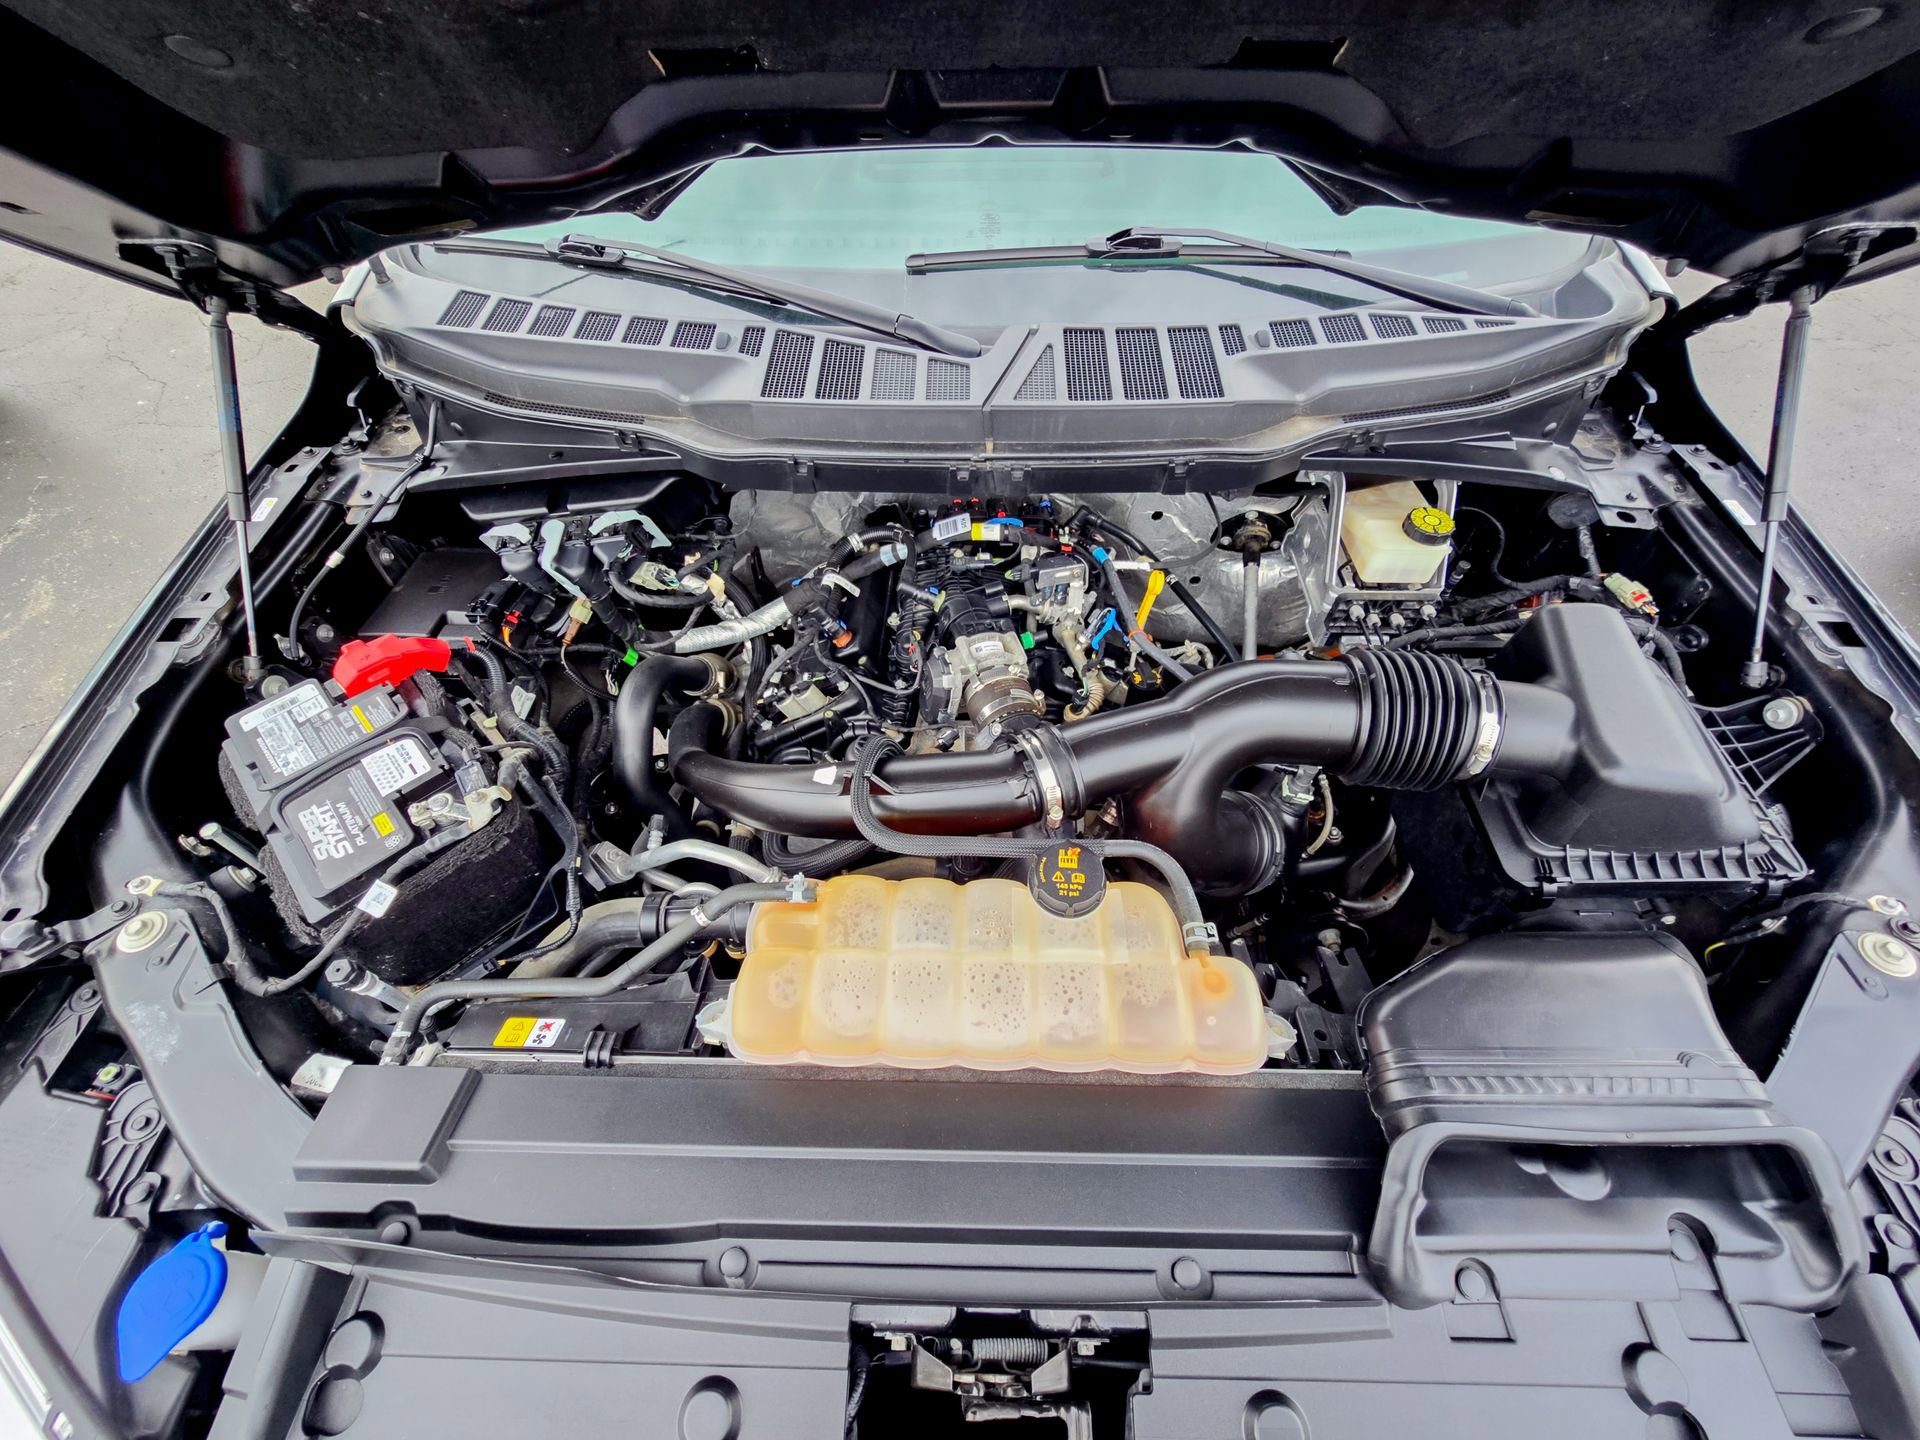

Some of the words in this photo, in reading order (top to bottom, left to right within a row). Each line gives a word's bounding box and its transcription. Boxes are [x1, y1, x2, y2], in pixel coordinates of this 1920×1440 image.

[297, 807, 330, 861] SUPER
[310, 802, 354, 859] START
[335, 801, 367, 847] PLATINUM
